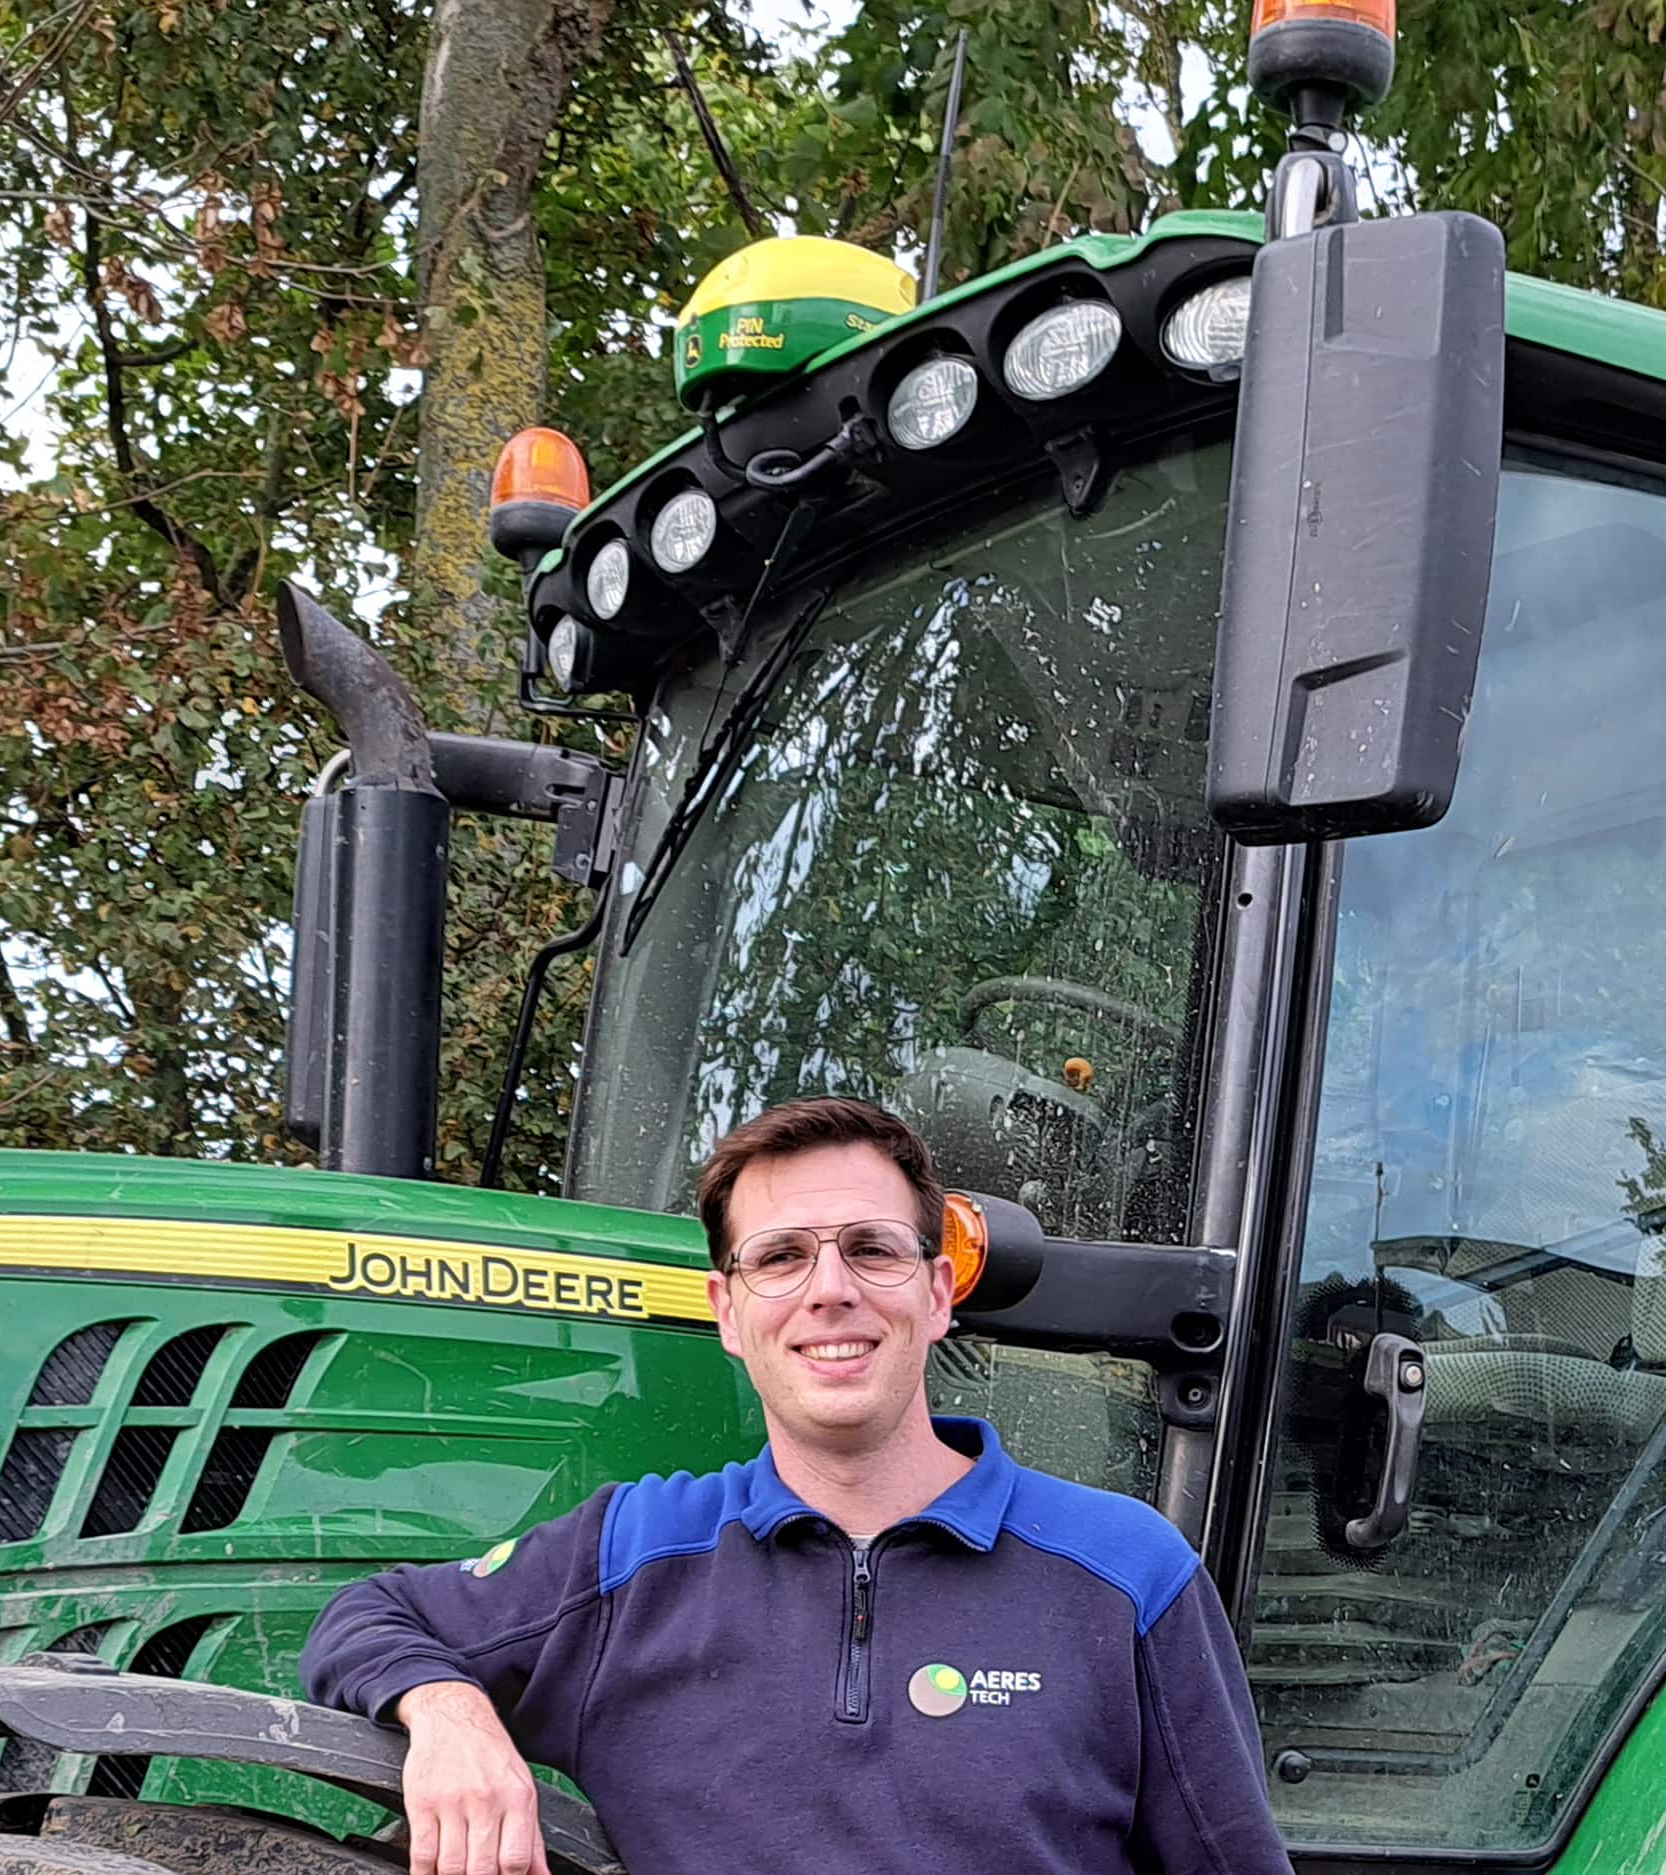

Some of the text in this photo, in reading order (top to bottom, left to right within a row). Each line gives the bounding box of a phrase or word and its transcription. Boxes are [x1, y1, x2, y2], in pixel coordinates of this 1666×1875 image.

[736, 317, 765, 335] PIN
[717, 333, 785, 349] Protected
[329, 1242, 644, 1313] JOHN DEERE
[969, 1669, 1042, 1692] AERES
[969, 1689, 1011, 1706] TECH
